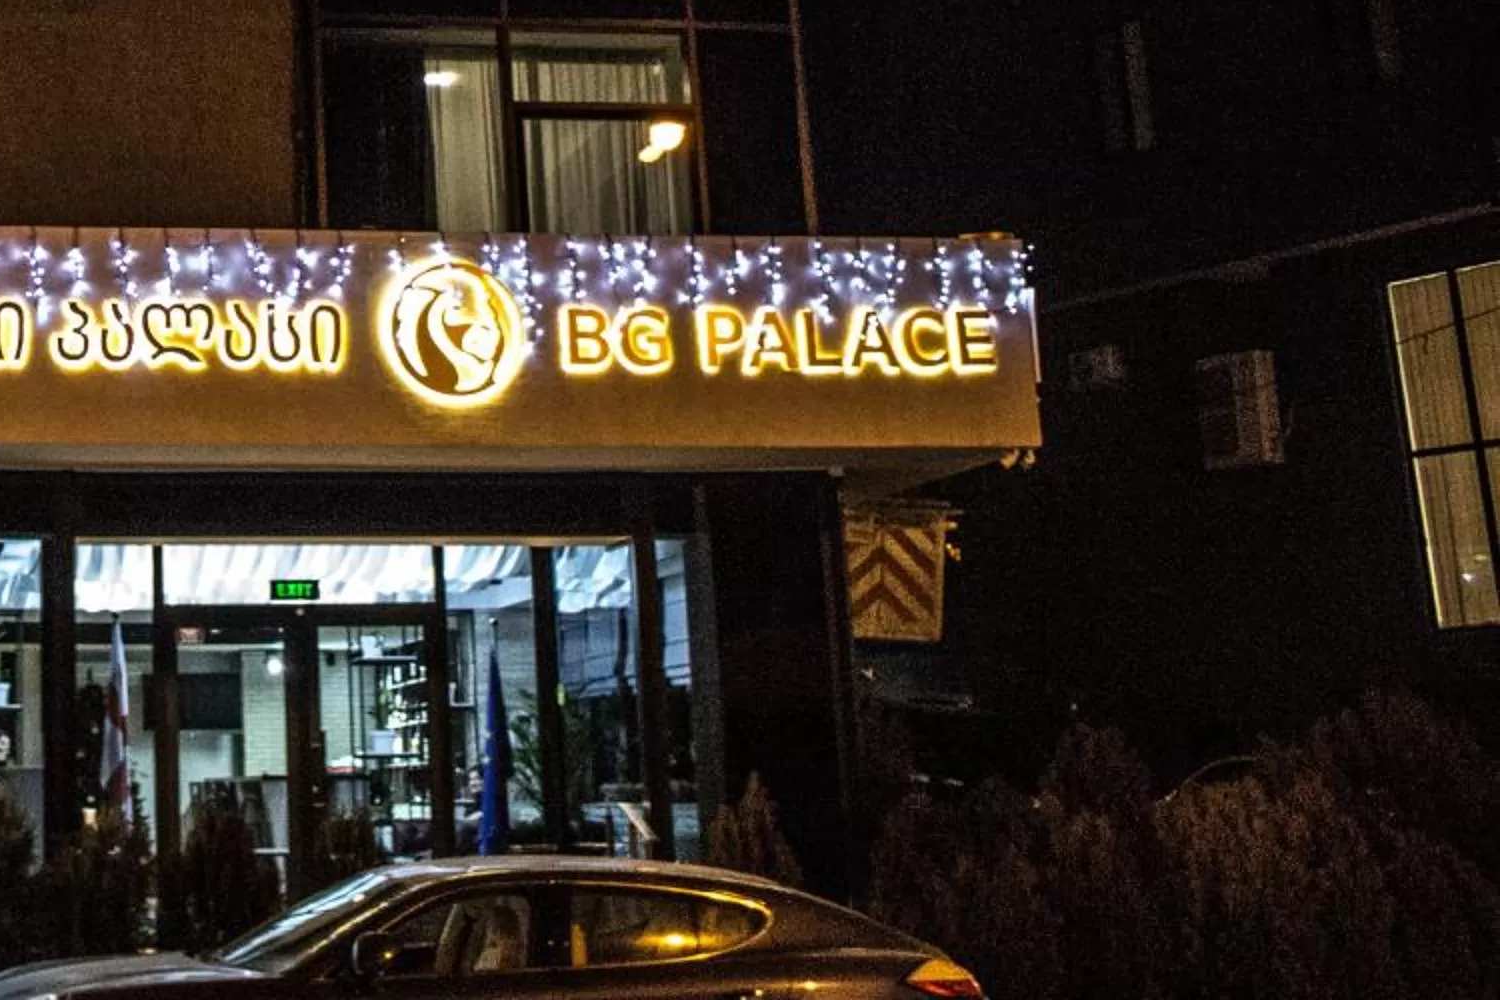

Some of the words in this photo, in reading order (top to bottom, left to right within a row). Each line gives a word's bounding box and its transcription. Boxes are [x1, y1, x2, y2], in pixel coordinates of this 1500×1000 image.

[55, 300, 346, 364] პალასი
[563, 305, 671, 370] BG
[702, 307, 999, 372] PALACE
[276, 583, 314, 597] EXIT
